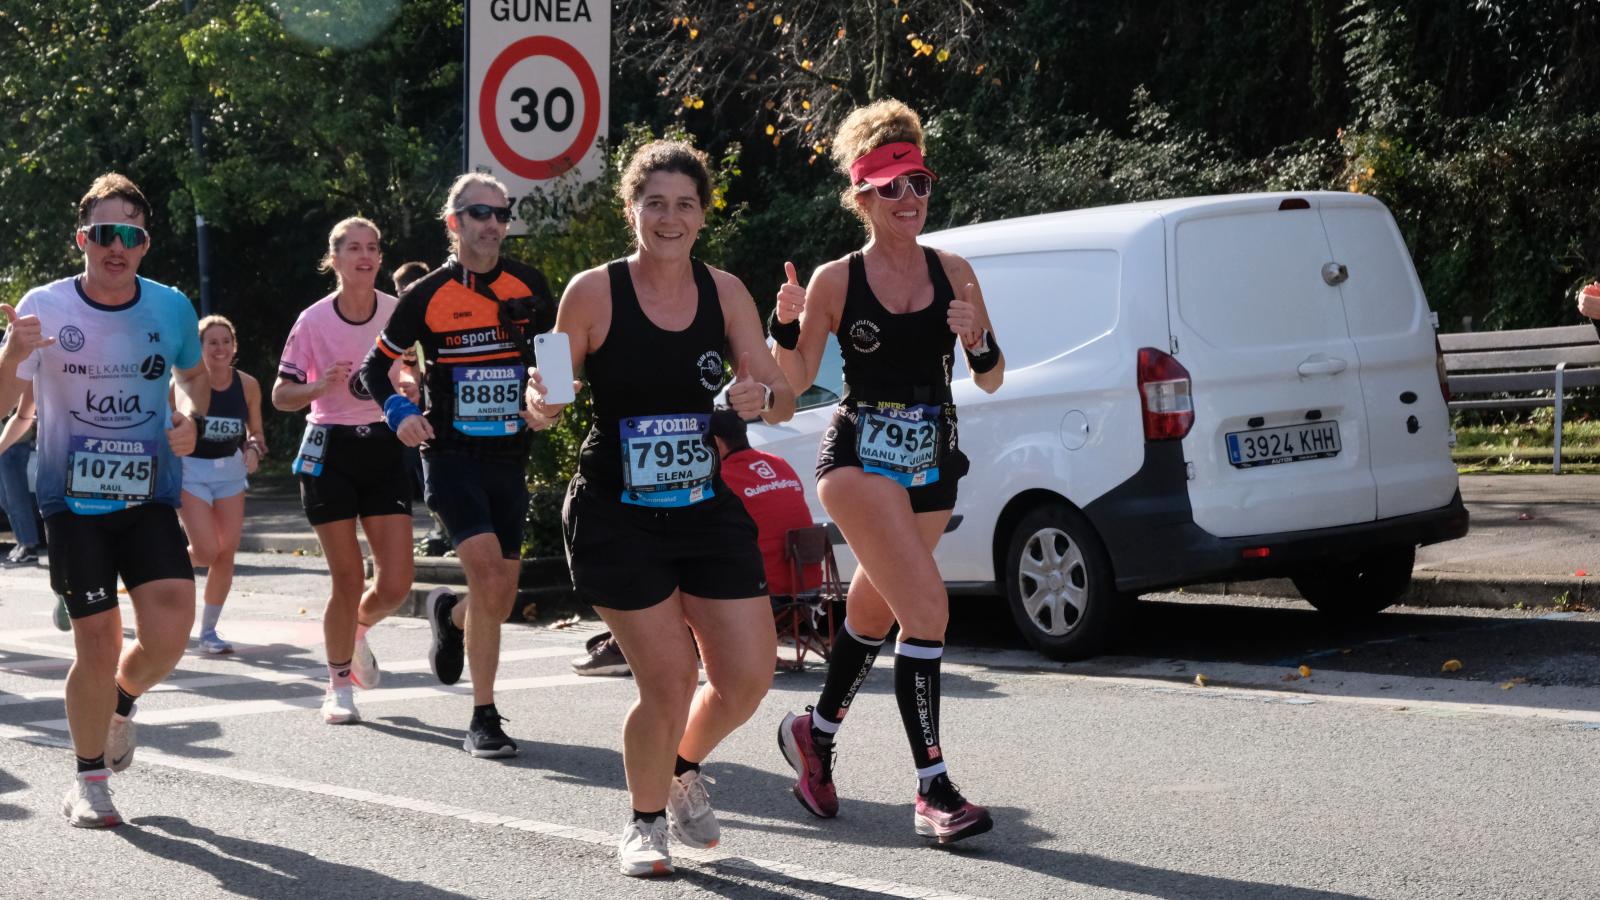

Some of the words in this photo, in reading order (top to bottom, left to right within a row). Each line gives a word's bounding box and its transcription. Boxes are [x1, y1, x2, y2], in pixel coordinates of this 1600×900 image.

[490, 0, 592, 22] GUNEA
[510, 87, 575, 133] 30
[62, 362, 140, 377] JONELKANO
[86, 389, 142, 414] kaia
[461, 384, 518, 404] 8885
[204, 418, 241, 435] 463
[867, 416, 935, 453] 7952
[1244, 432, 1295, 459] 3924
[1299, 427, 1337, 452] KHH
[632, 439, 710, 470] 7955
[861, 447, 896, 461] MANU
[899, 453, 907, 463] Y
[910, 451, 933, 466] JUAN
[77, 457, 151, 481] 10745
[657, 470, 693, 482] ELENA
[100, 484, 123, 492] RAUL
